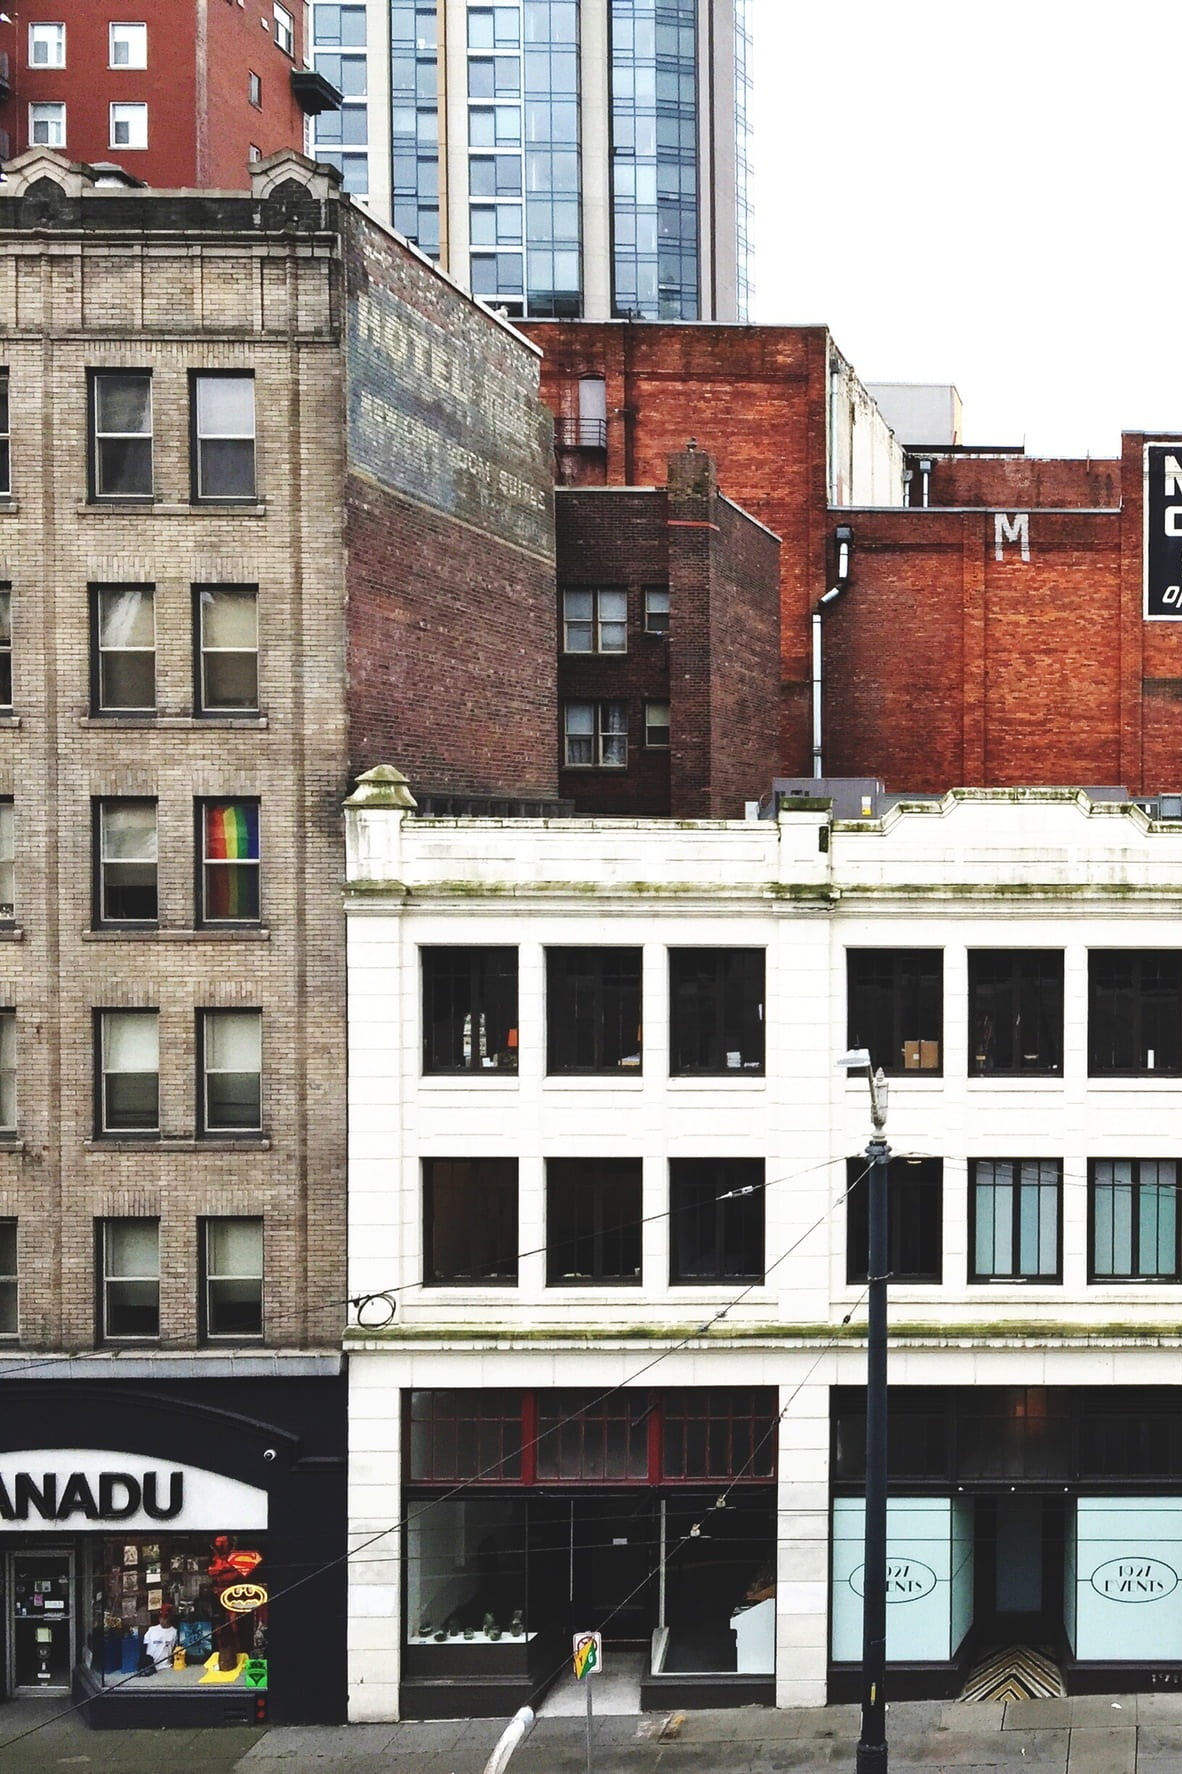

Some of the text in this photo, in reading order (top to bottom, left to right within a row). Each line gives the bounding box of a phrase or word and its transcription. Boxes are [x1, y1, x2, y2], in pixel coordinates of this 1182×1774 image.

[994, 513, 1031, 562] M
[1119, 1565, 1151, 1578] 1927
[1104, 1580, 1164, 1593] EVENTS
